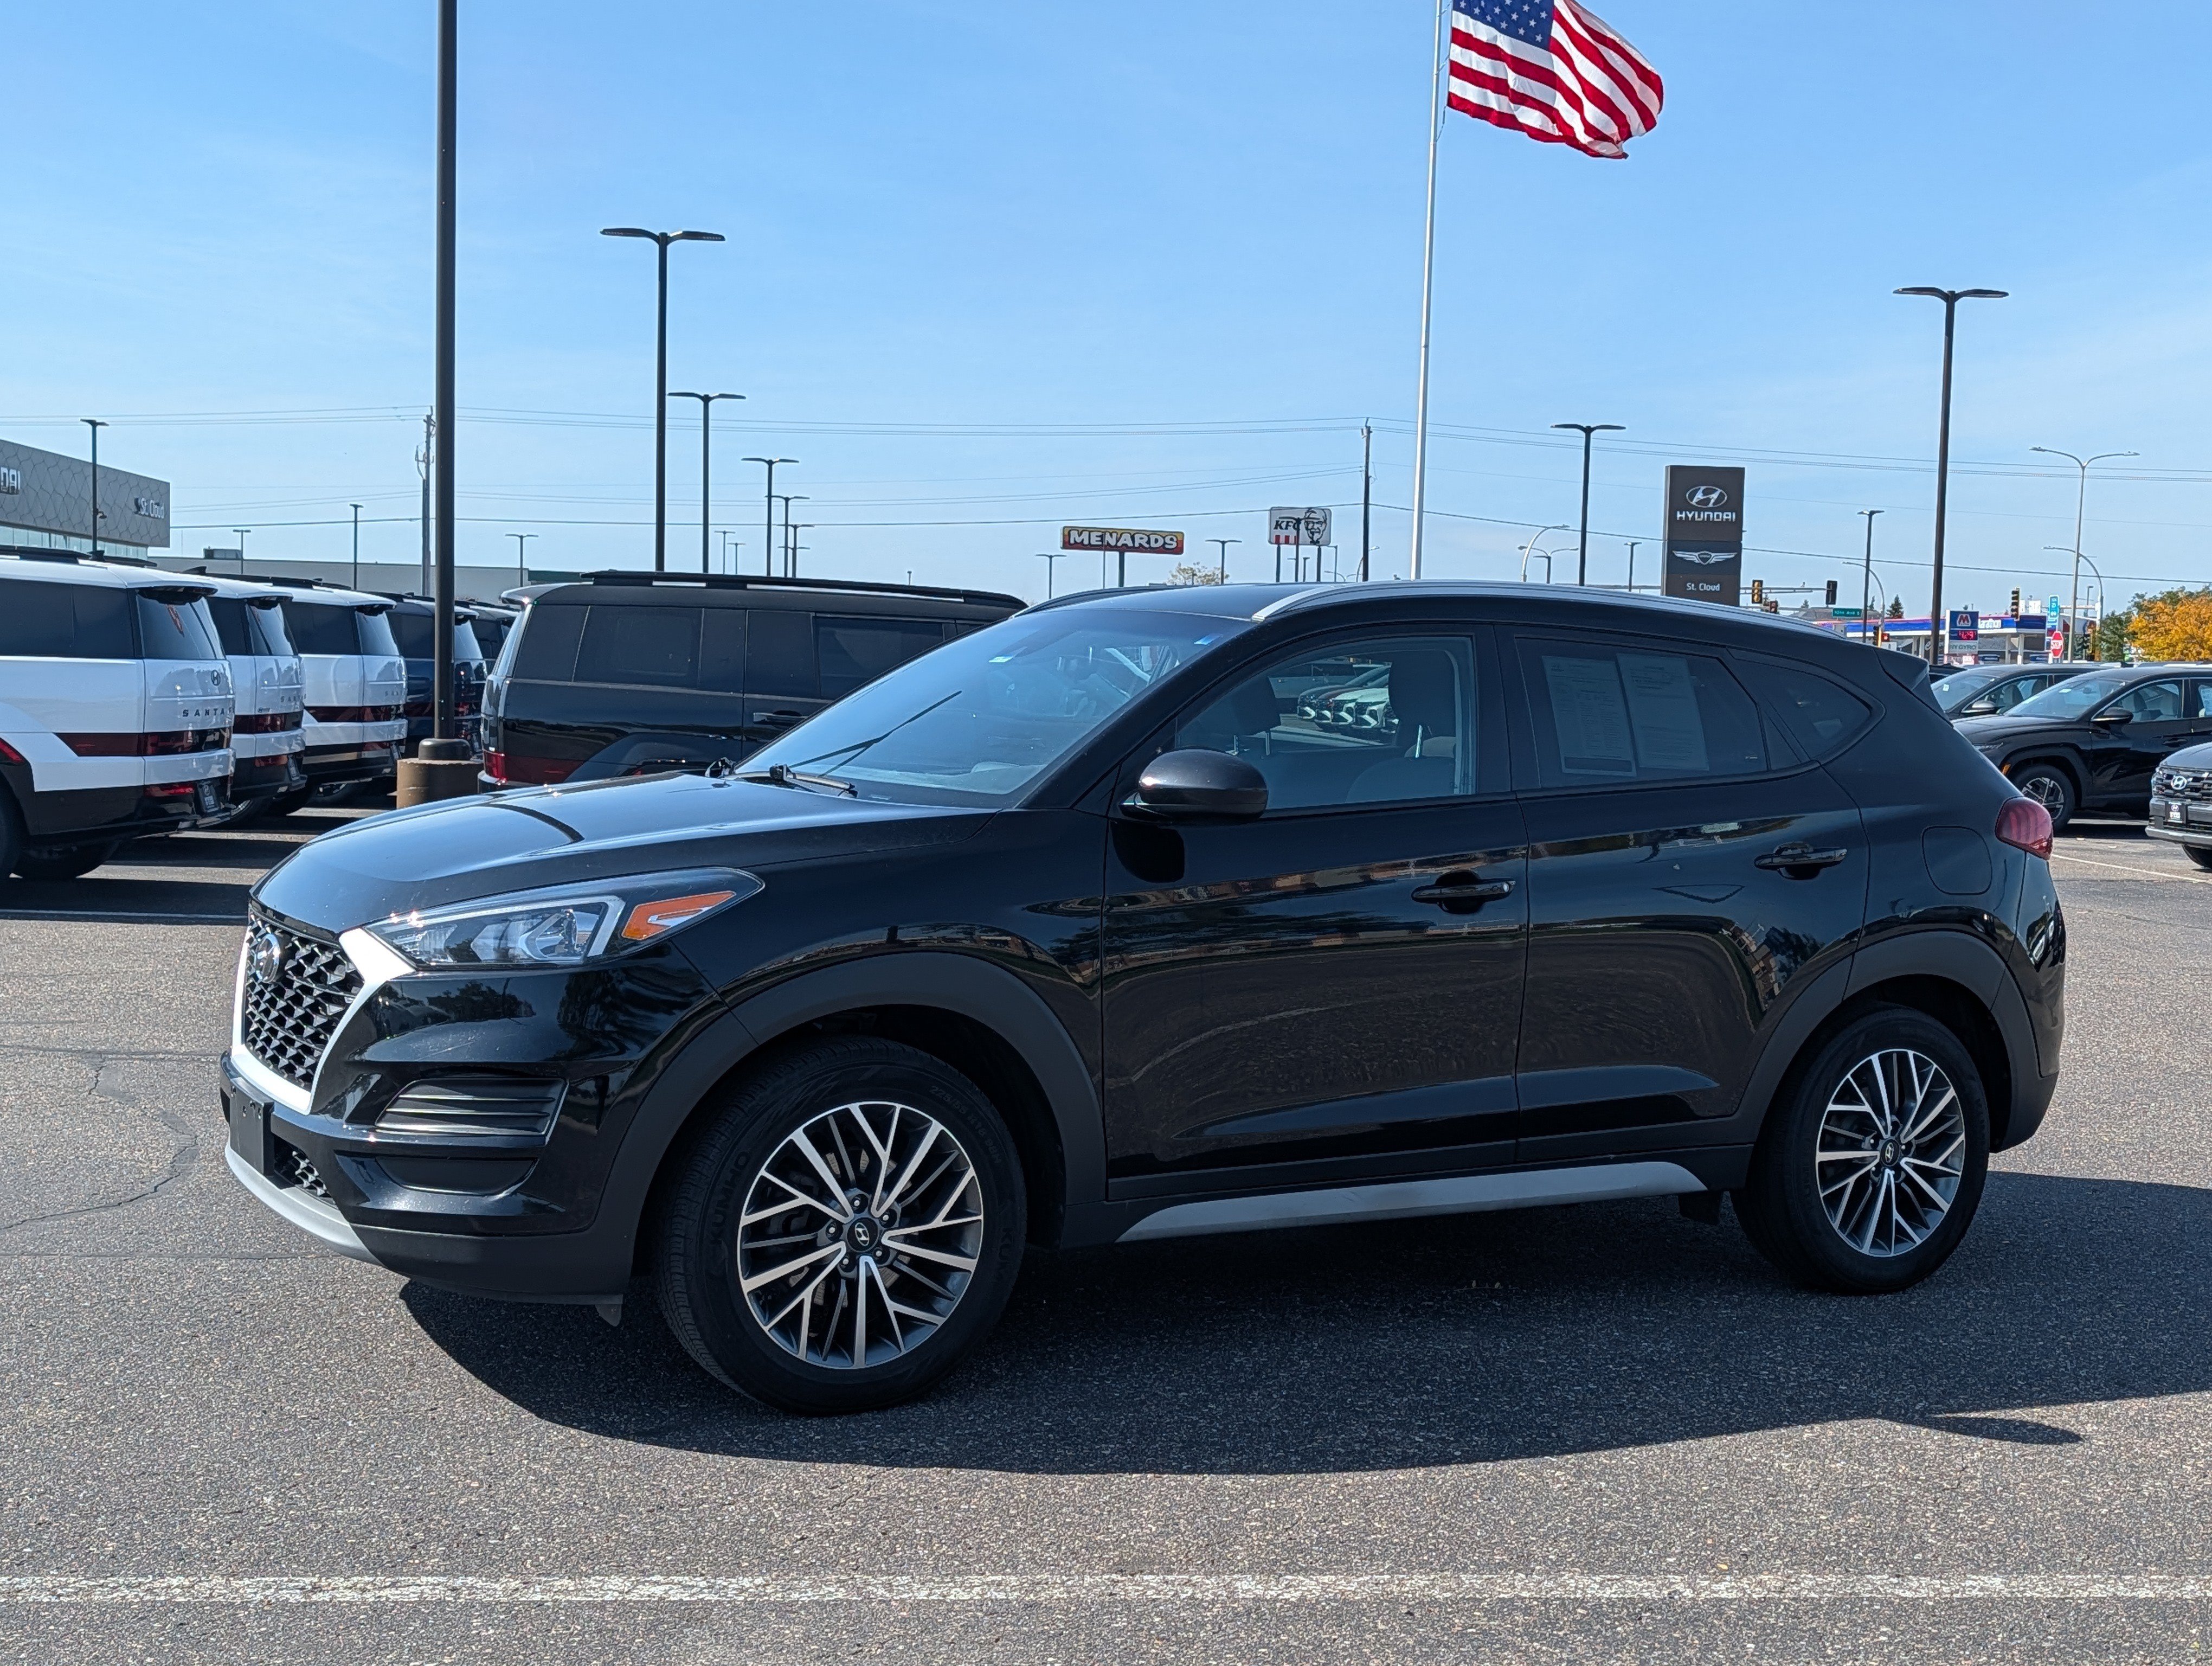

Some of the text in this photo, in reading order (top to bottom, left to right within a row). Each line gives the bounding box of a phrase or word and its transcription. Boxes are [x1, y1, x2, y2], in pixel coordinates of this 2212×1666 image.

[1676, 511, 1736, 522] HYUNDAI
[1070, 530, 1177, 549] MENARDS
[1686, 582, 1720, 591] St. Cloud
[183, 708, 224, 717] SANTA
[710, 1151, 750, 1245] KUMHO
